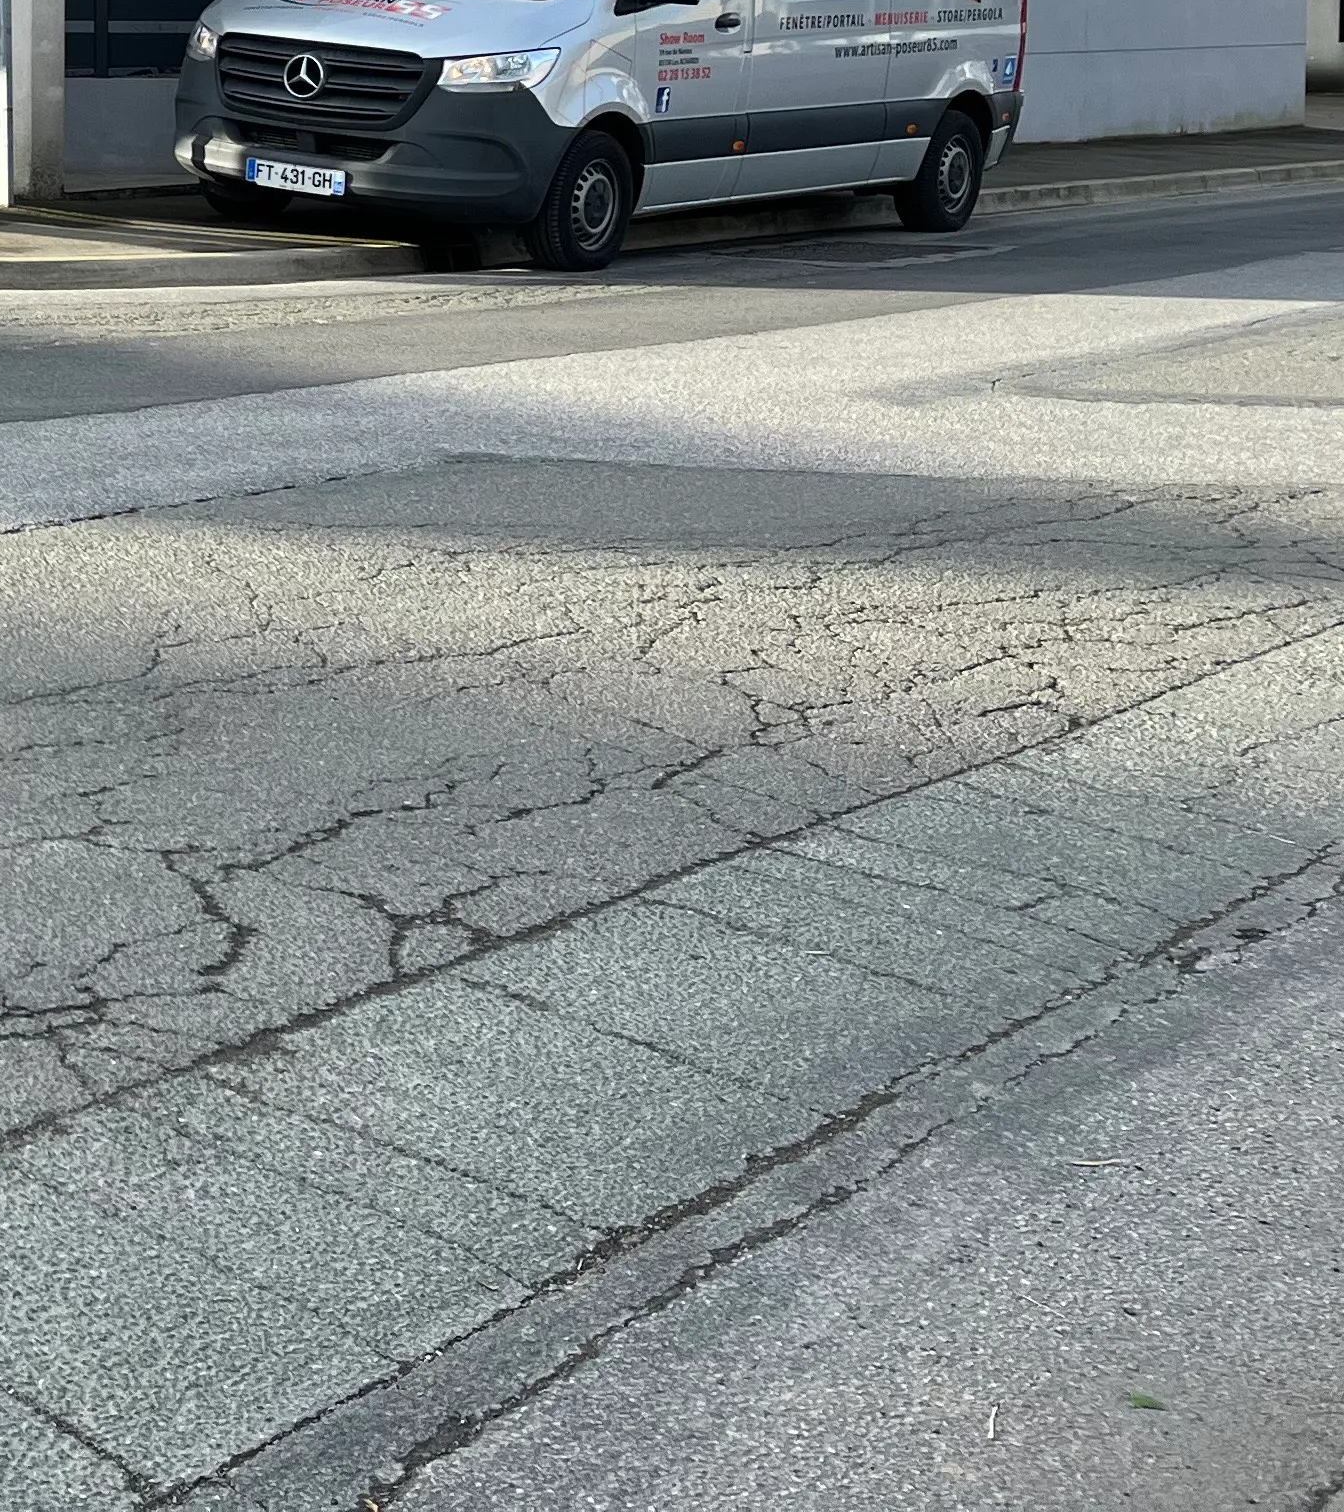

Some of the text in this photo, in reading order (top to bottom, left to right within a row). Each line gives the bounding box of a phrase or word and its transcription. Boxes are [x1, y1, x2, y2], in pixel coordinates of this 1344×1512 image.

[780, 7, 1003, 31] FENÊTRE/PORTAIL MENUISERIE STORE/PERGOLA
[659, 32, 681, 45] Show
[835, 38, 957, 58] www.artisan-poseur85.com
[658, 70, 667, 81] 02
[681, 68, 689, 79] 15
[701, 67, 711, 78] 52
[256, 163, 333, 189] FT-431-GH
